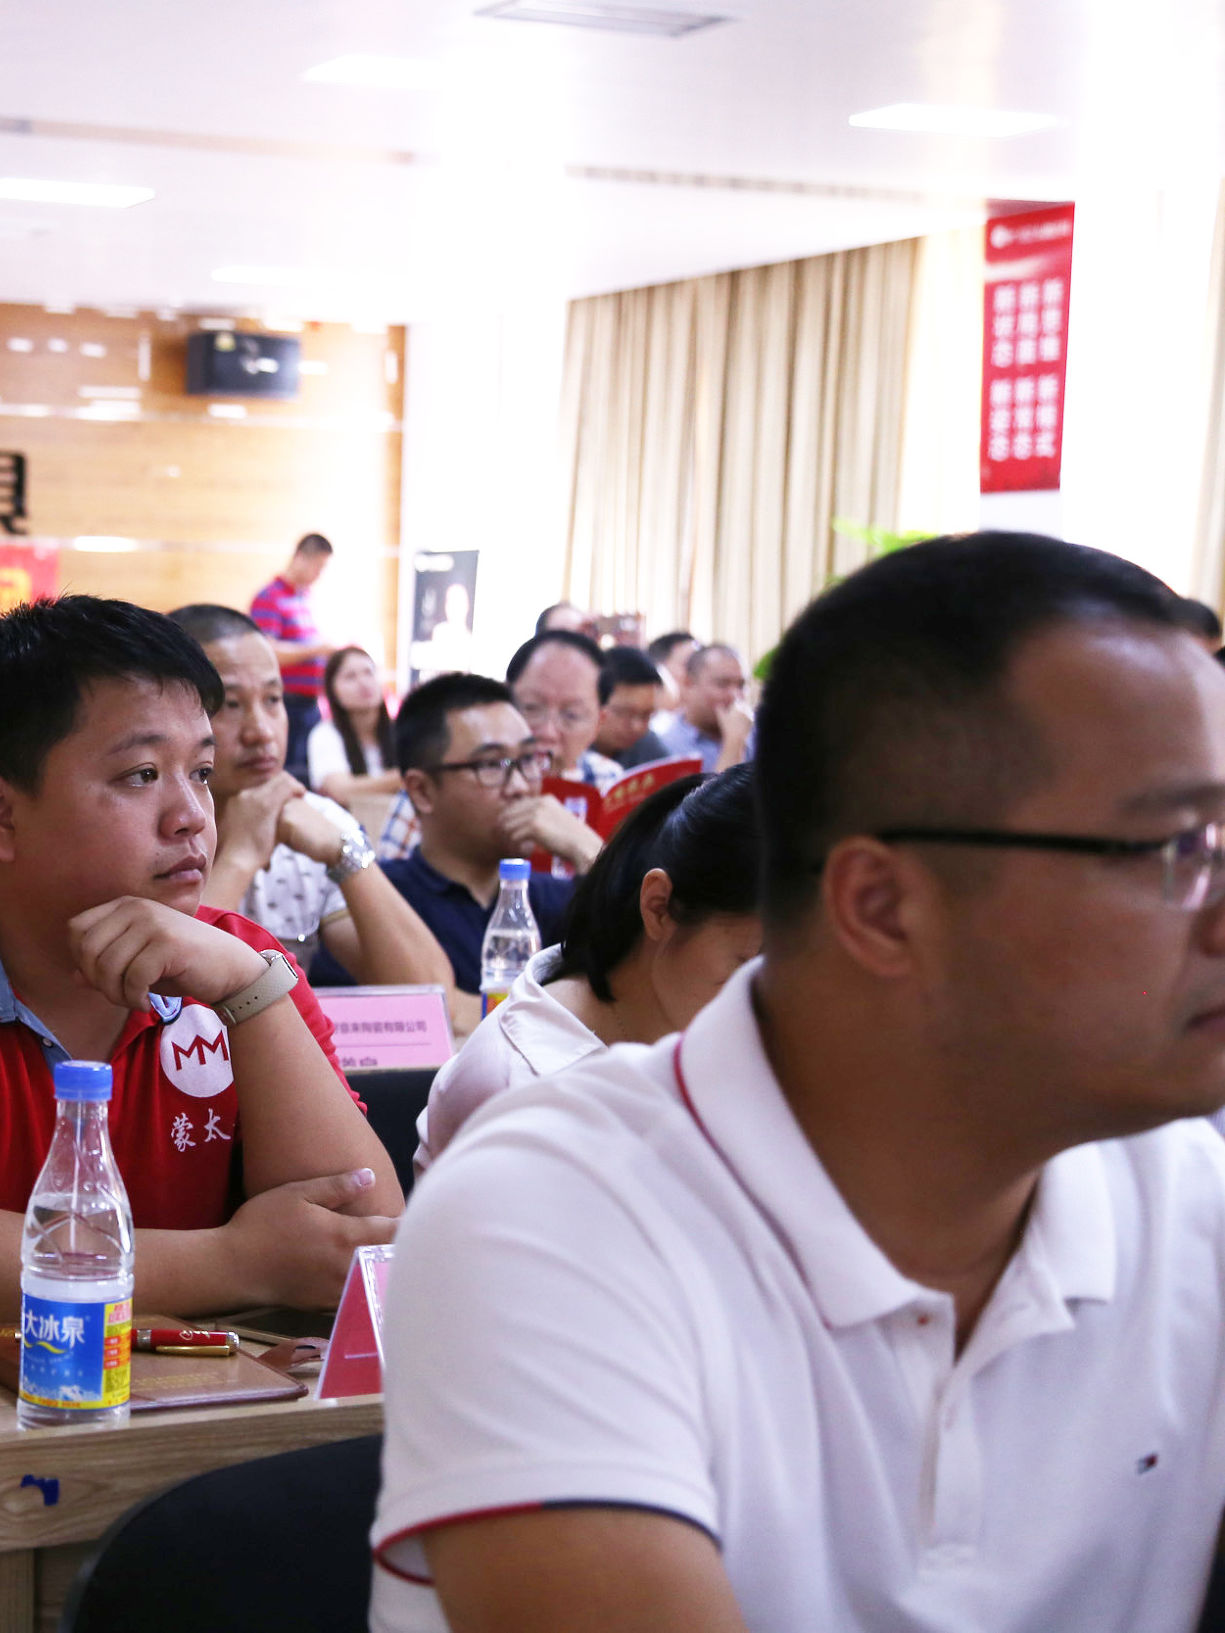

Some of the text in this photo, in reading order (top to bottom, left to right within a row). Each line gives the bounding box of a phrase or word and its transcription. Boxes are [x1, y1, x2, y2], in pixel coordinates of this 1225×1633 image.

[171, 1108, 231, 1152] 蒙太
[25, 1309, 85, 1348] 大冰泉
